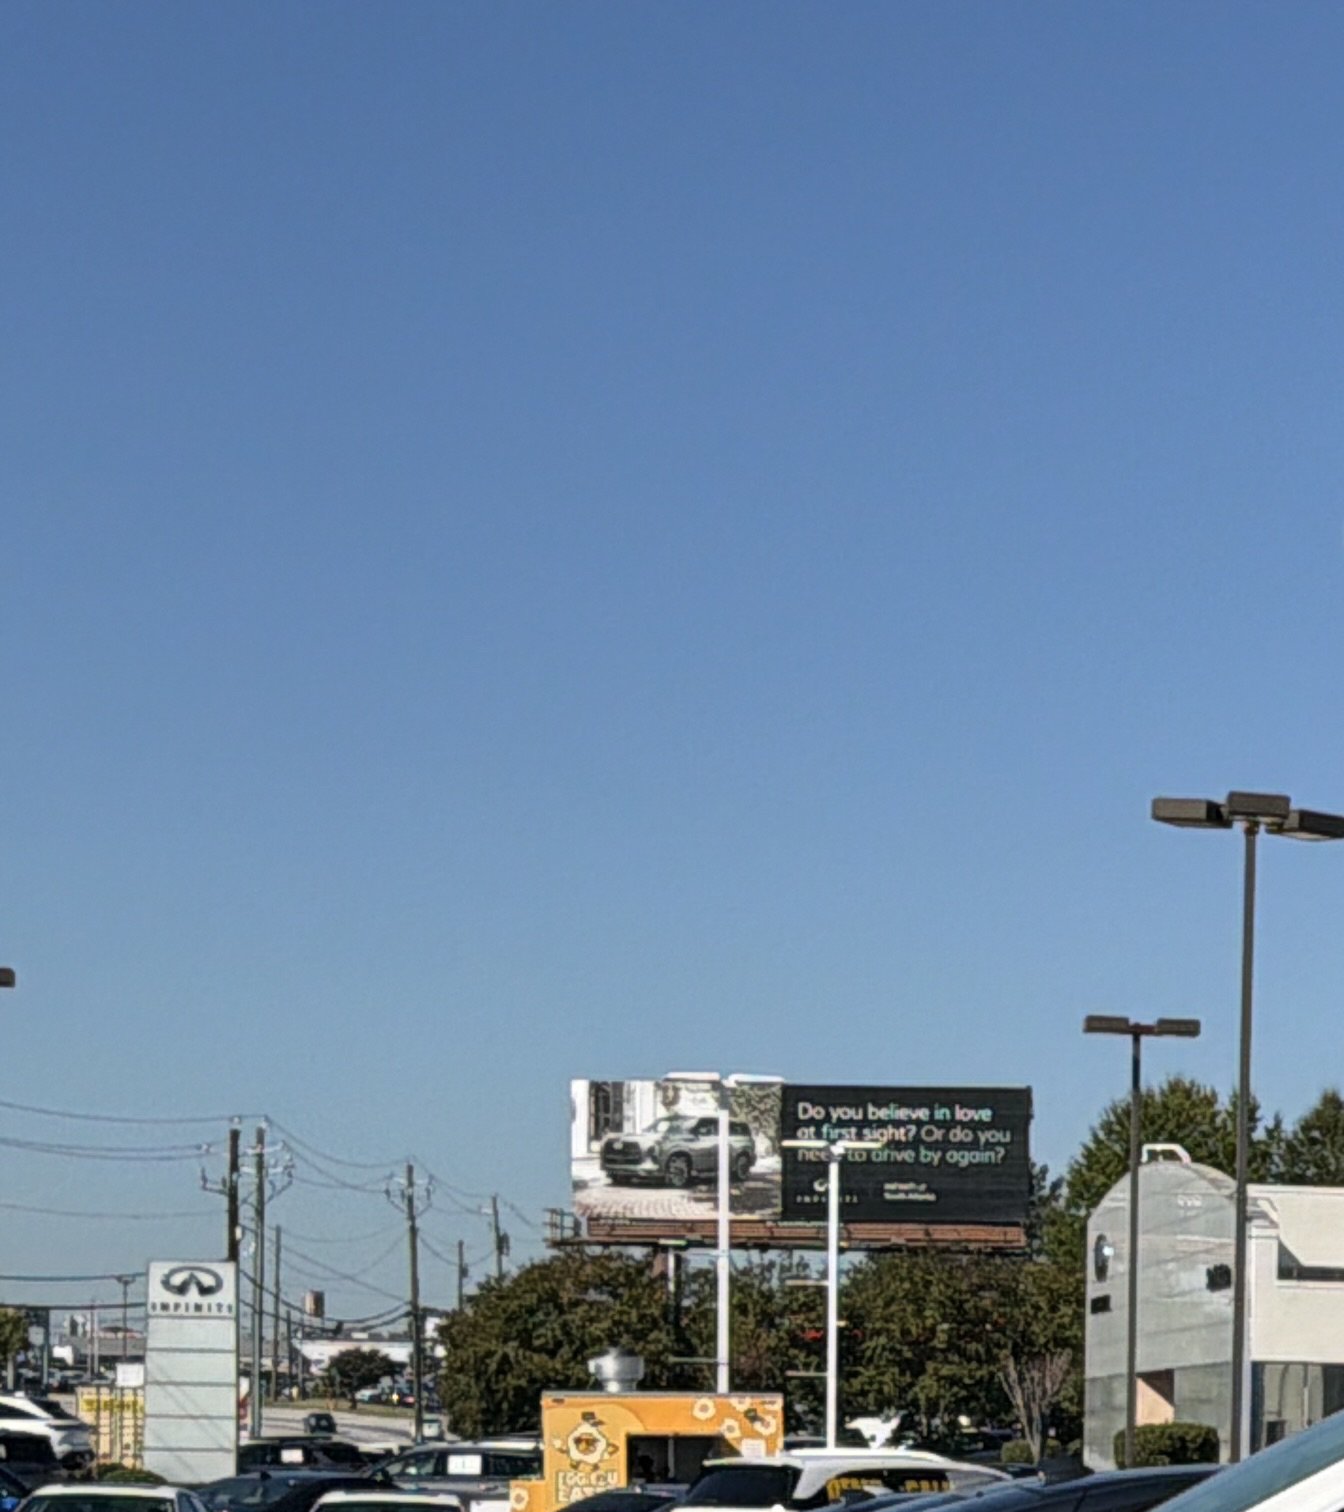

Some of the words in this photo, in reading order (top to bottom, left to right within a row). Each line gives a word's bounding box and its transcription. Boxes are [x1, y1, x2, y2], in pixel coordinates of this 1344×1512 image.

[797, 1102, 825, 1120] Do
[830, 1105, 863, 1123] you
[867, 1101, 929, 1121] believe
[934, 1102, 951, 1120] in
[955, 1103, 992, 1121] love
[797, 1125, 816, 1140] at
[821, 1123, 857, 1140] first
[863, 1124, 917, 1144] sight?
[921, 1125, 945, 1142] Or
[949, 1125, 973, 1142] do
[977, 1128, 1011, 1146] you
[847, 1148, 865, 1163] to
[919, 1147, 942, 1166] by
[946, 1147, 1005, 1168] again?
[151, 1301, 233, 1314] INFINITI
